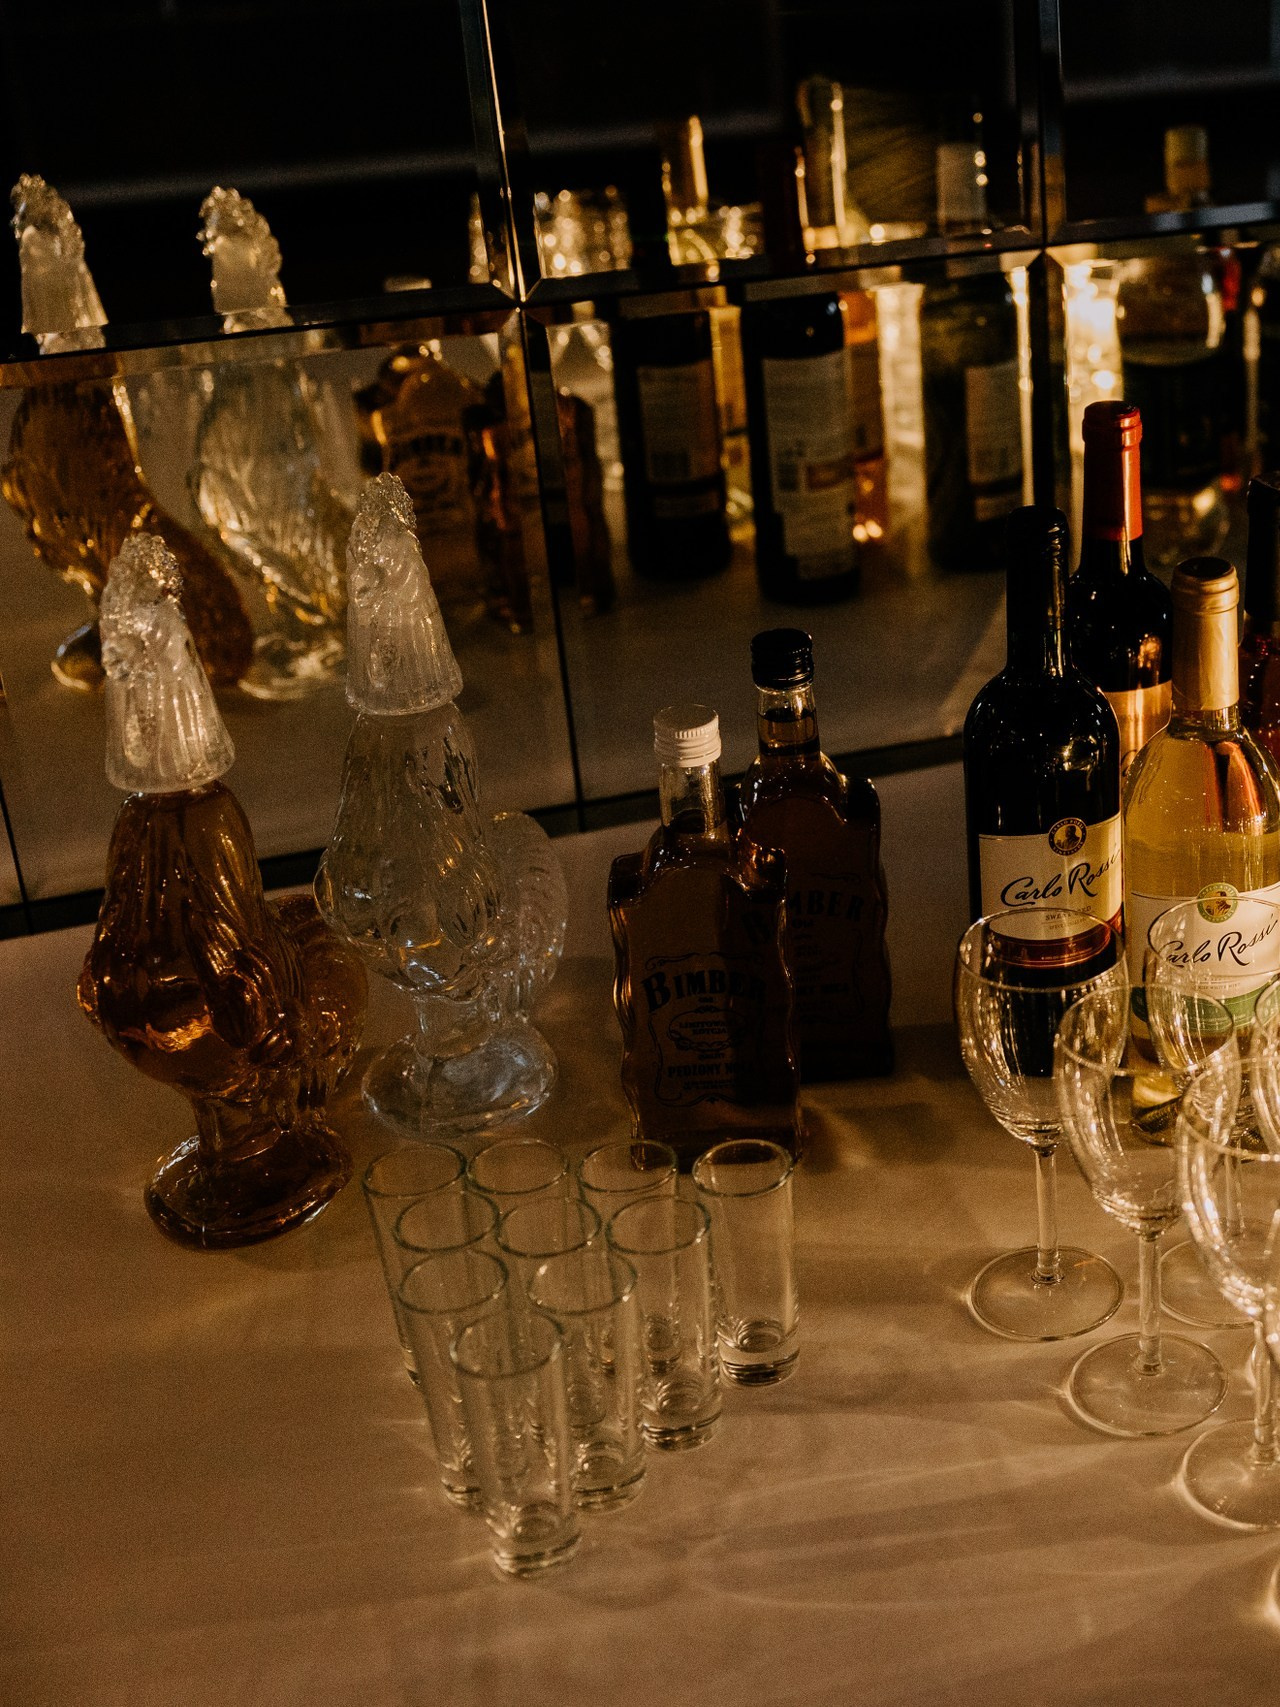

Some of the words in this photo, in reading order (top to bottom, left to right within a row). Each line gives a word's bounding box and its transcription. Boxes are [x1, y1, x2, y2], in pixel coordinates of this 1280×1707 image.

[1001, 873, 1062, 907] Carlo
[1068, 843, 1120, 897] Rossi
[1161, 939, 1211, 968] Carlo
[1218, 913, 1278, 967] Rossi
[641, 969, 767, 1014] BIMBER
